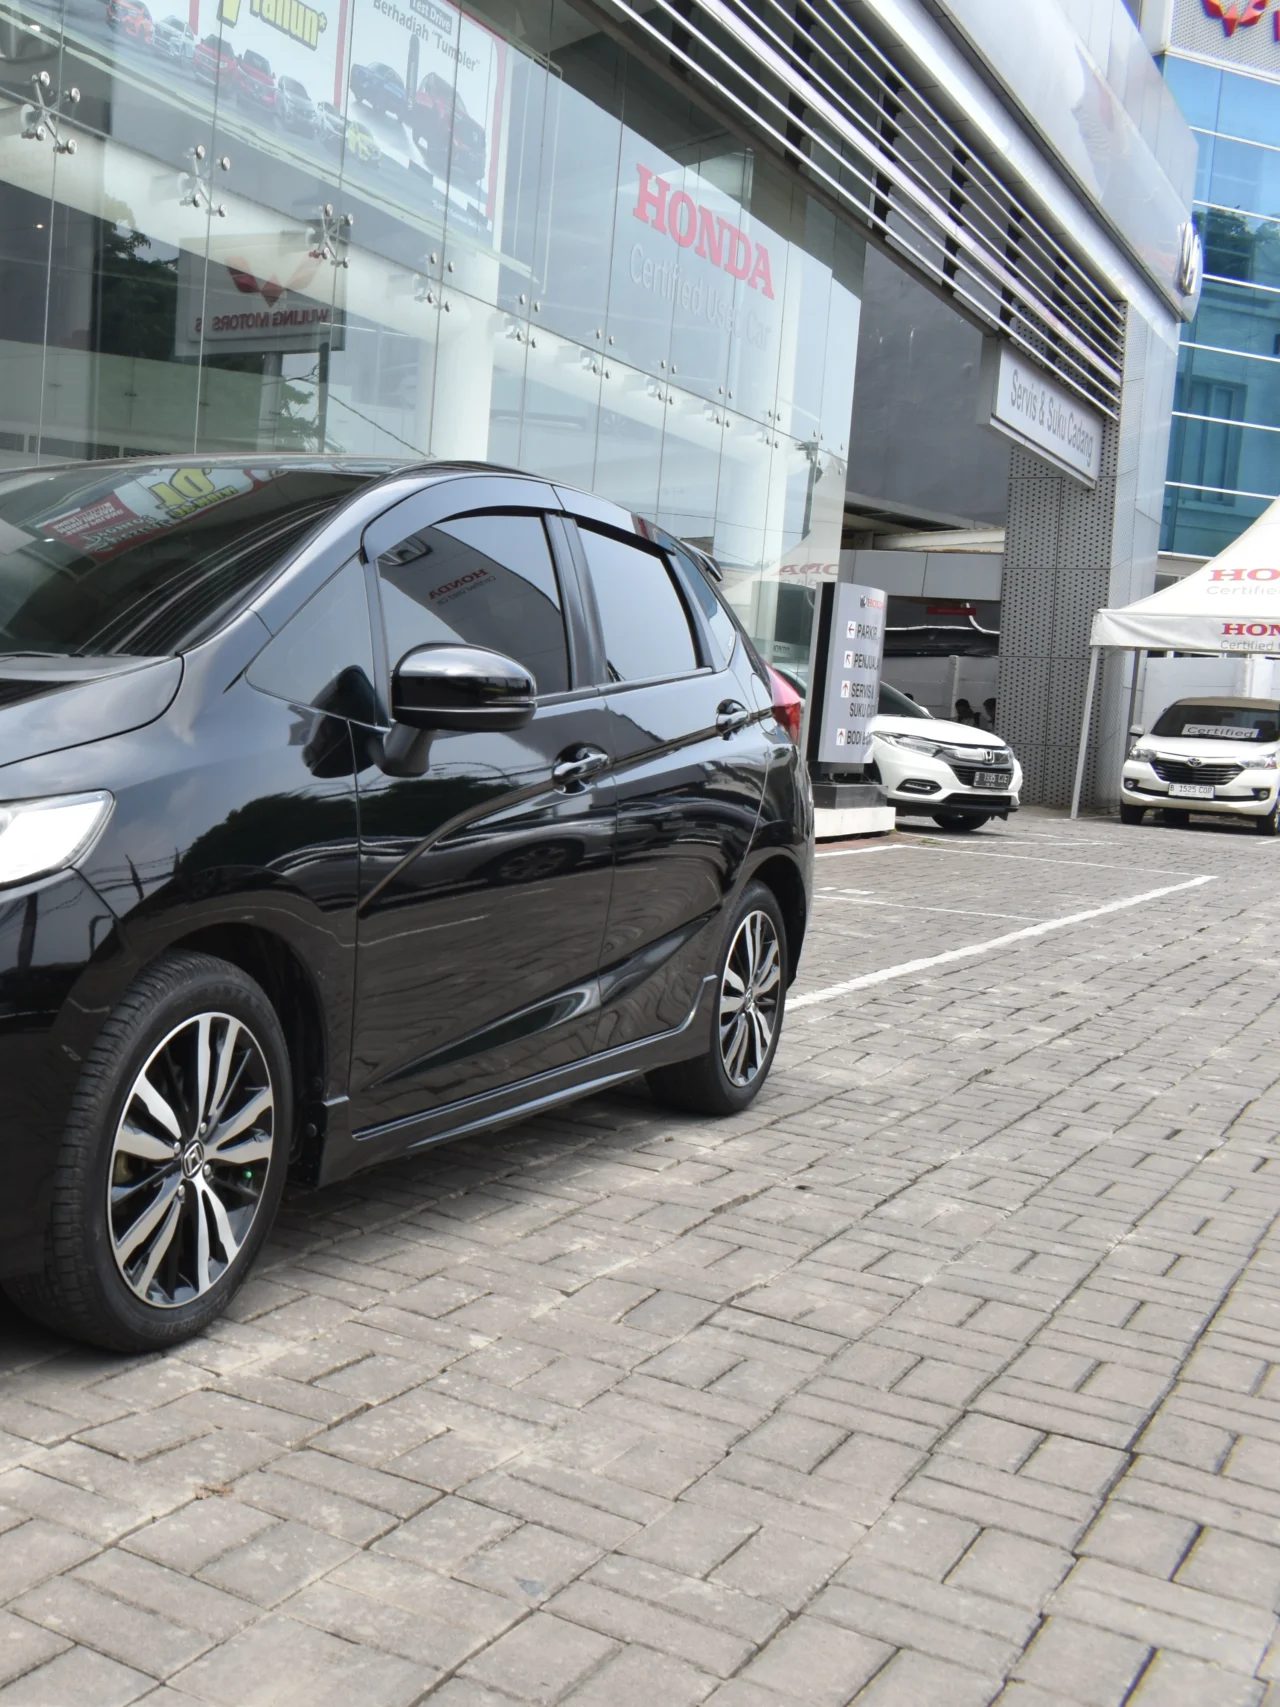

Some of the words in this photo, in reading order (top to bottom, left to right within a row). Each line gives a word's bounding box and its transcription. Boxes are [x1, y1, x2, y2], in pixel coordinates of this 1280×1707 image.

[249, 0, 327, 51] ahun
[373, 0, 428, 41] Berhadiah
[430, 8, 451, 30] Drive
[633, 163, 775, 300] HONDA
[630, 243, 702, 316] Certified
[1010, 368, 1037, 421] Servis
[1038, 390, 1045, 426] &
[1046, 396, 1068, 441] Suku
[1068, 412, 1094, 468] Cadang
[1206, 586, 1280, 595] Certifie
[857, 623, 878, 639] PARKIR
[1220, 639, 1274, 651] Certified
[851, 683, 871, 699] SERVIS
[849, 702, 866, 717] SUKU
[846, 730, 862, 745] BODI
[1187, 726, 1253, 737] Certified
[1178, 785, 1196, 793] 1525
